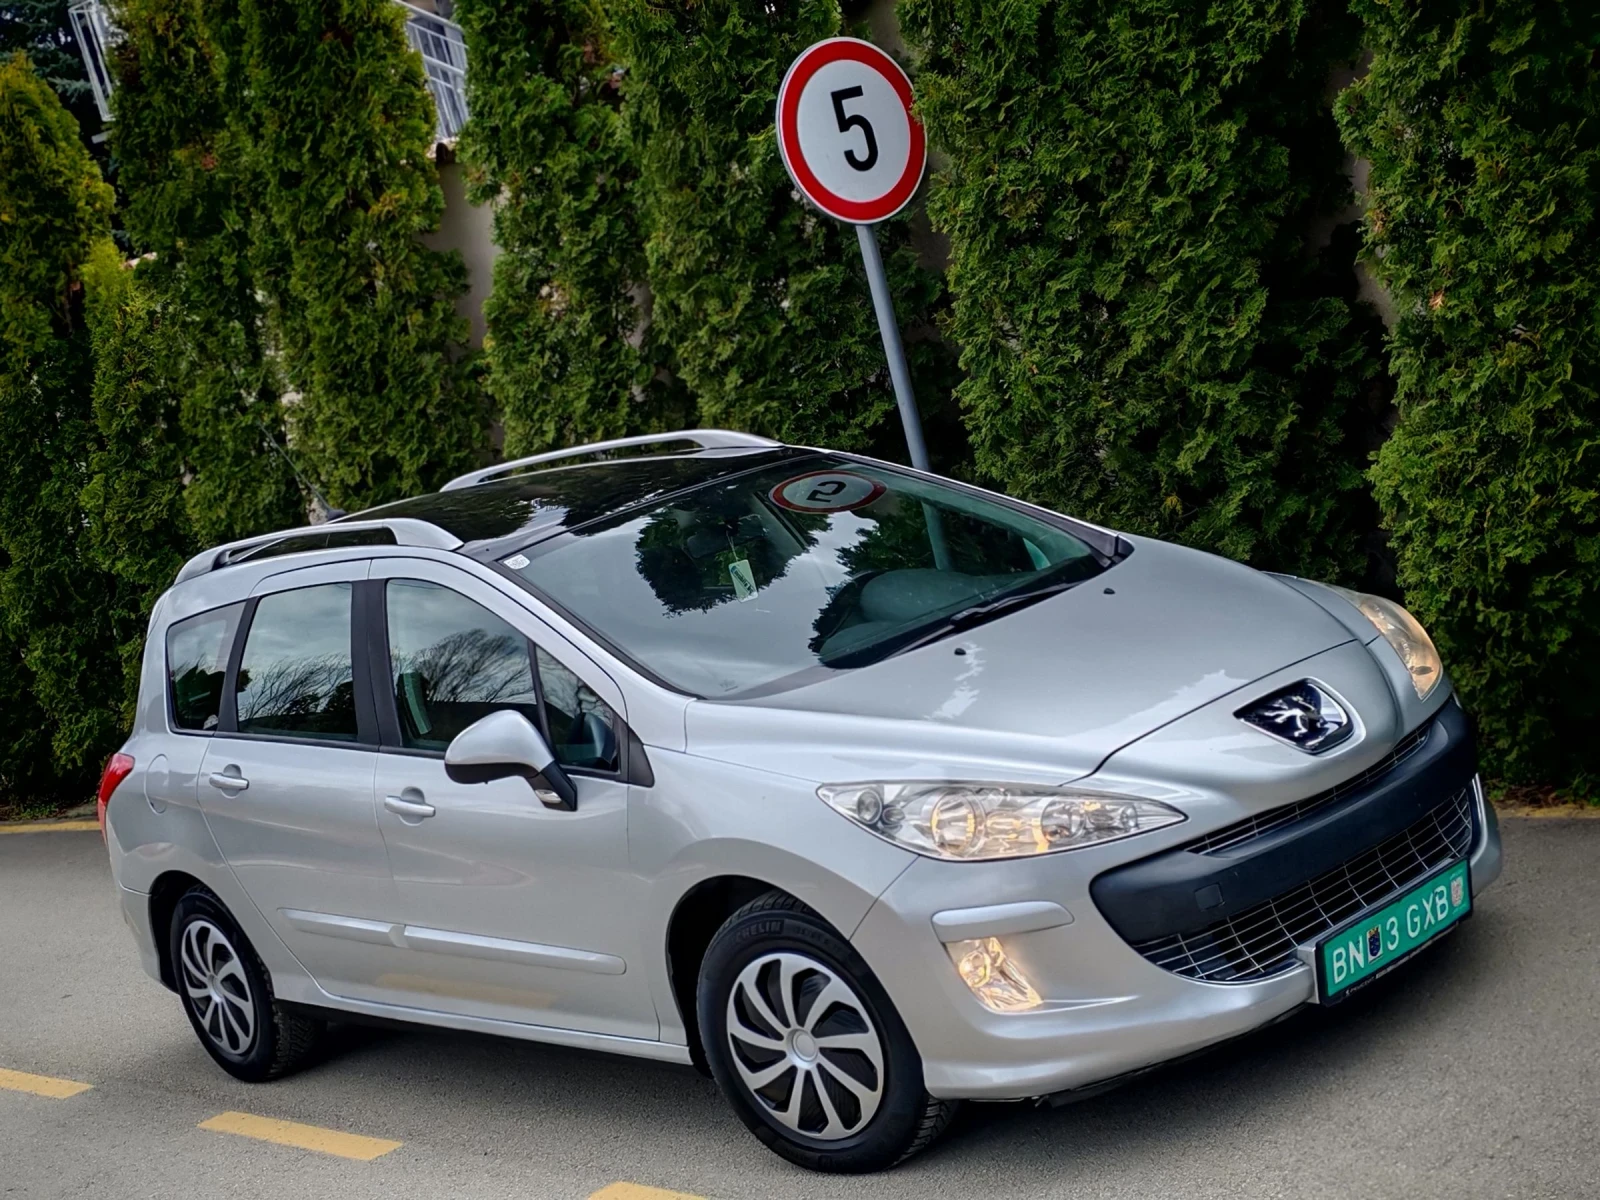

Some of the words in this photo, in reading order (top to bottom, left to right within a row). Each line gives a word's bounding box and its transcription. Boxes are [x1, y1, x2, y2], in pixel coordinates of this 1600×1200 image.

[831, 85, 878, 171] 5
[1332, 936, 1364, 984] BN
[1386, 916, 1399, 951] 3
[1406, 885, 1449, 939] GXB
